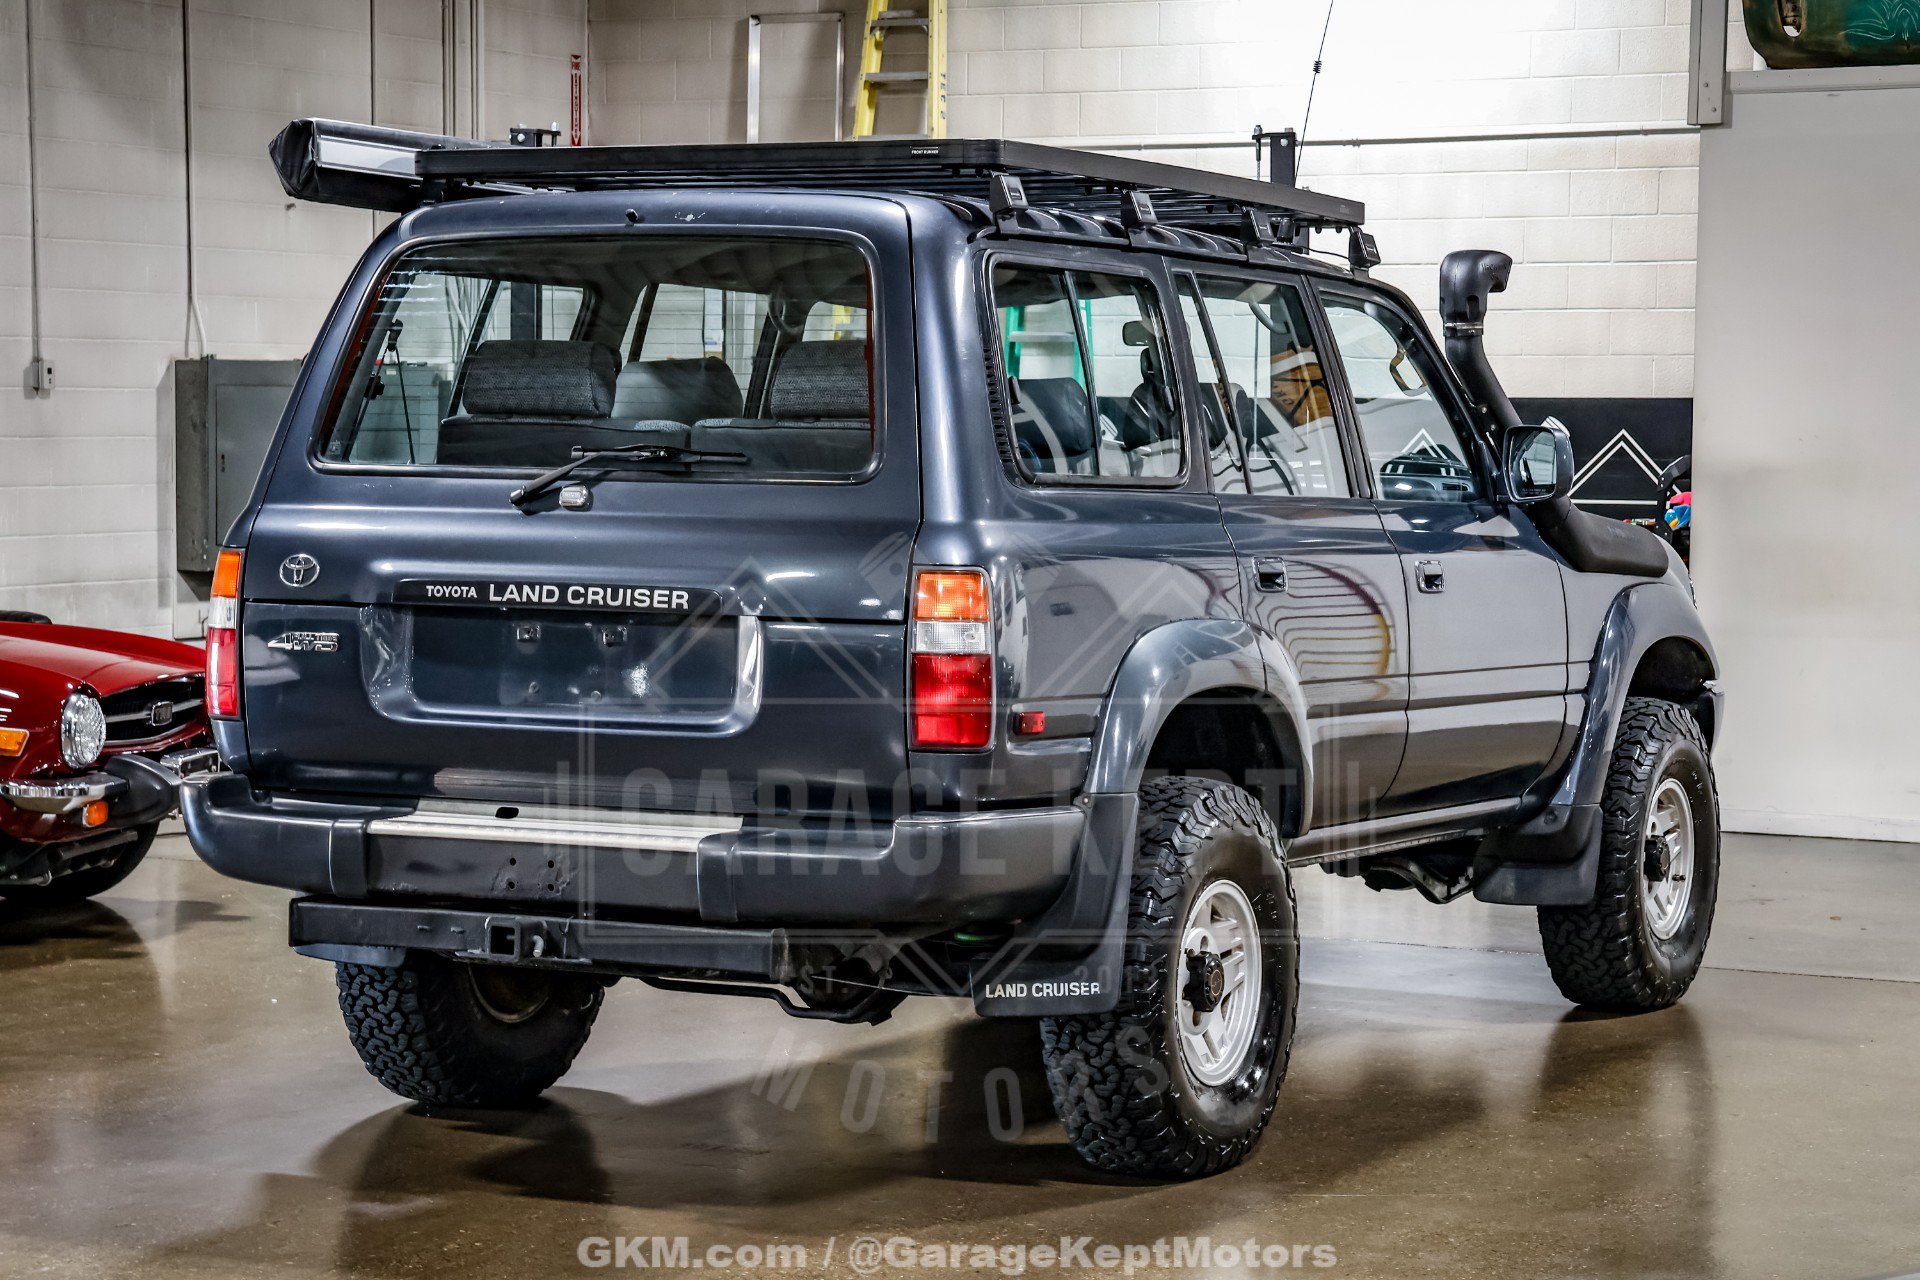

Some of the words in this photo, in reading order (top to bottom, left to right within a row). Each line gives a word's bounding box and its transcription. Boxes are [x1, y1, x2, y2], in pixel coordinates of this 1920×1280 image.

[426, 585, 478, 599] TOYOTA
[489, 584, 559, 604] LAND
[567, 586, 689, 609] CRUISER
[985, 983, 1027, 998] LAND
[1031, 982, 1101, 998] CRUISER
